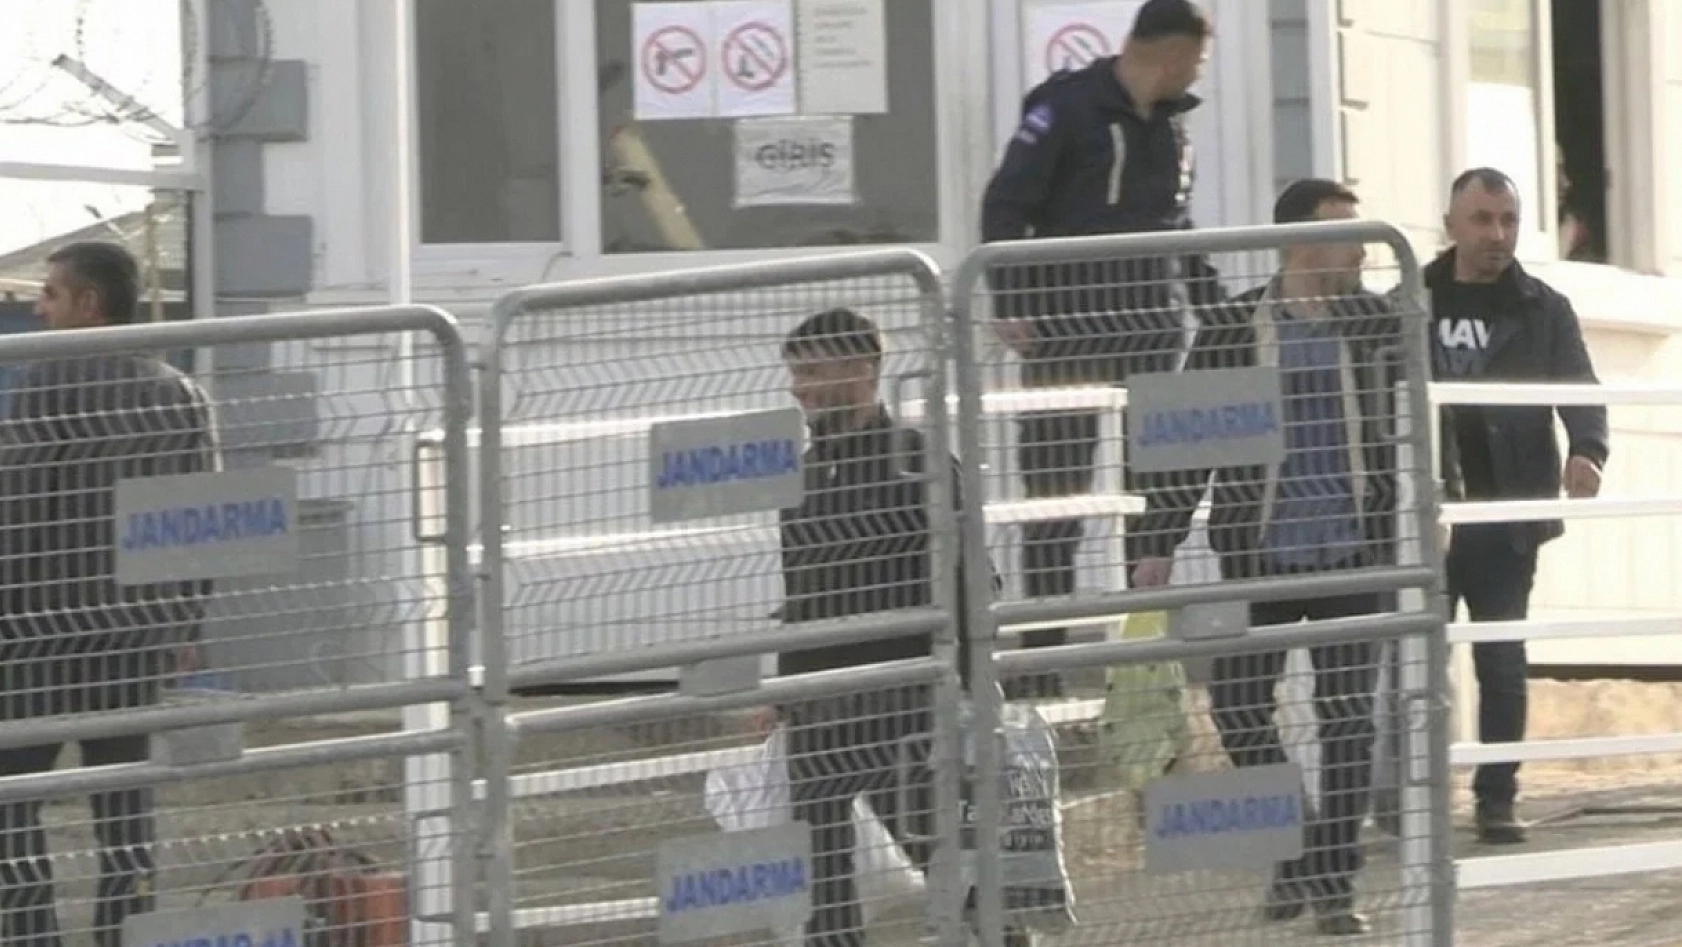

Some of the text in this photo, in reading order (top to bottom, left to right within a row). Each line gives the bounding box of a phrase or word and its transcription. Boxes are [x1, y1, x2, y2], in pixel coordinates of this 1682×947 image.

[1138, 401, 1278, 447] JANDARMA
[656, 439, 799, 489] JANDARMA
[122, 496, 288, 551] JANDARMA
[1156, 794, 1301, 839] JANDARMA
[666, 857, 807, 912] JANDARMA
